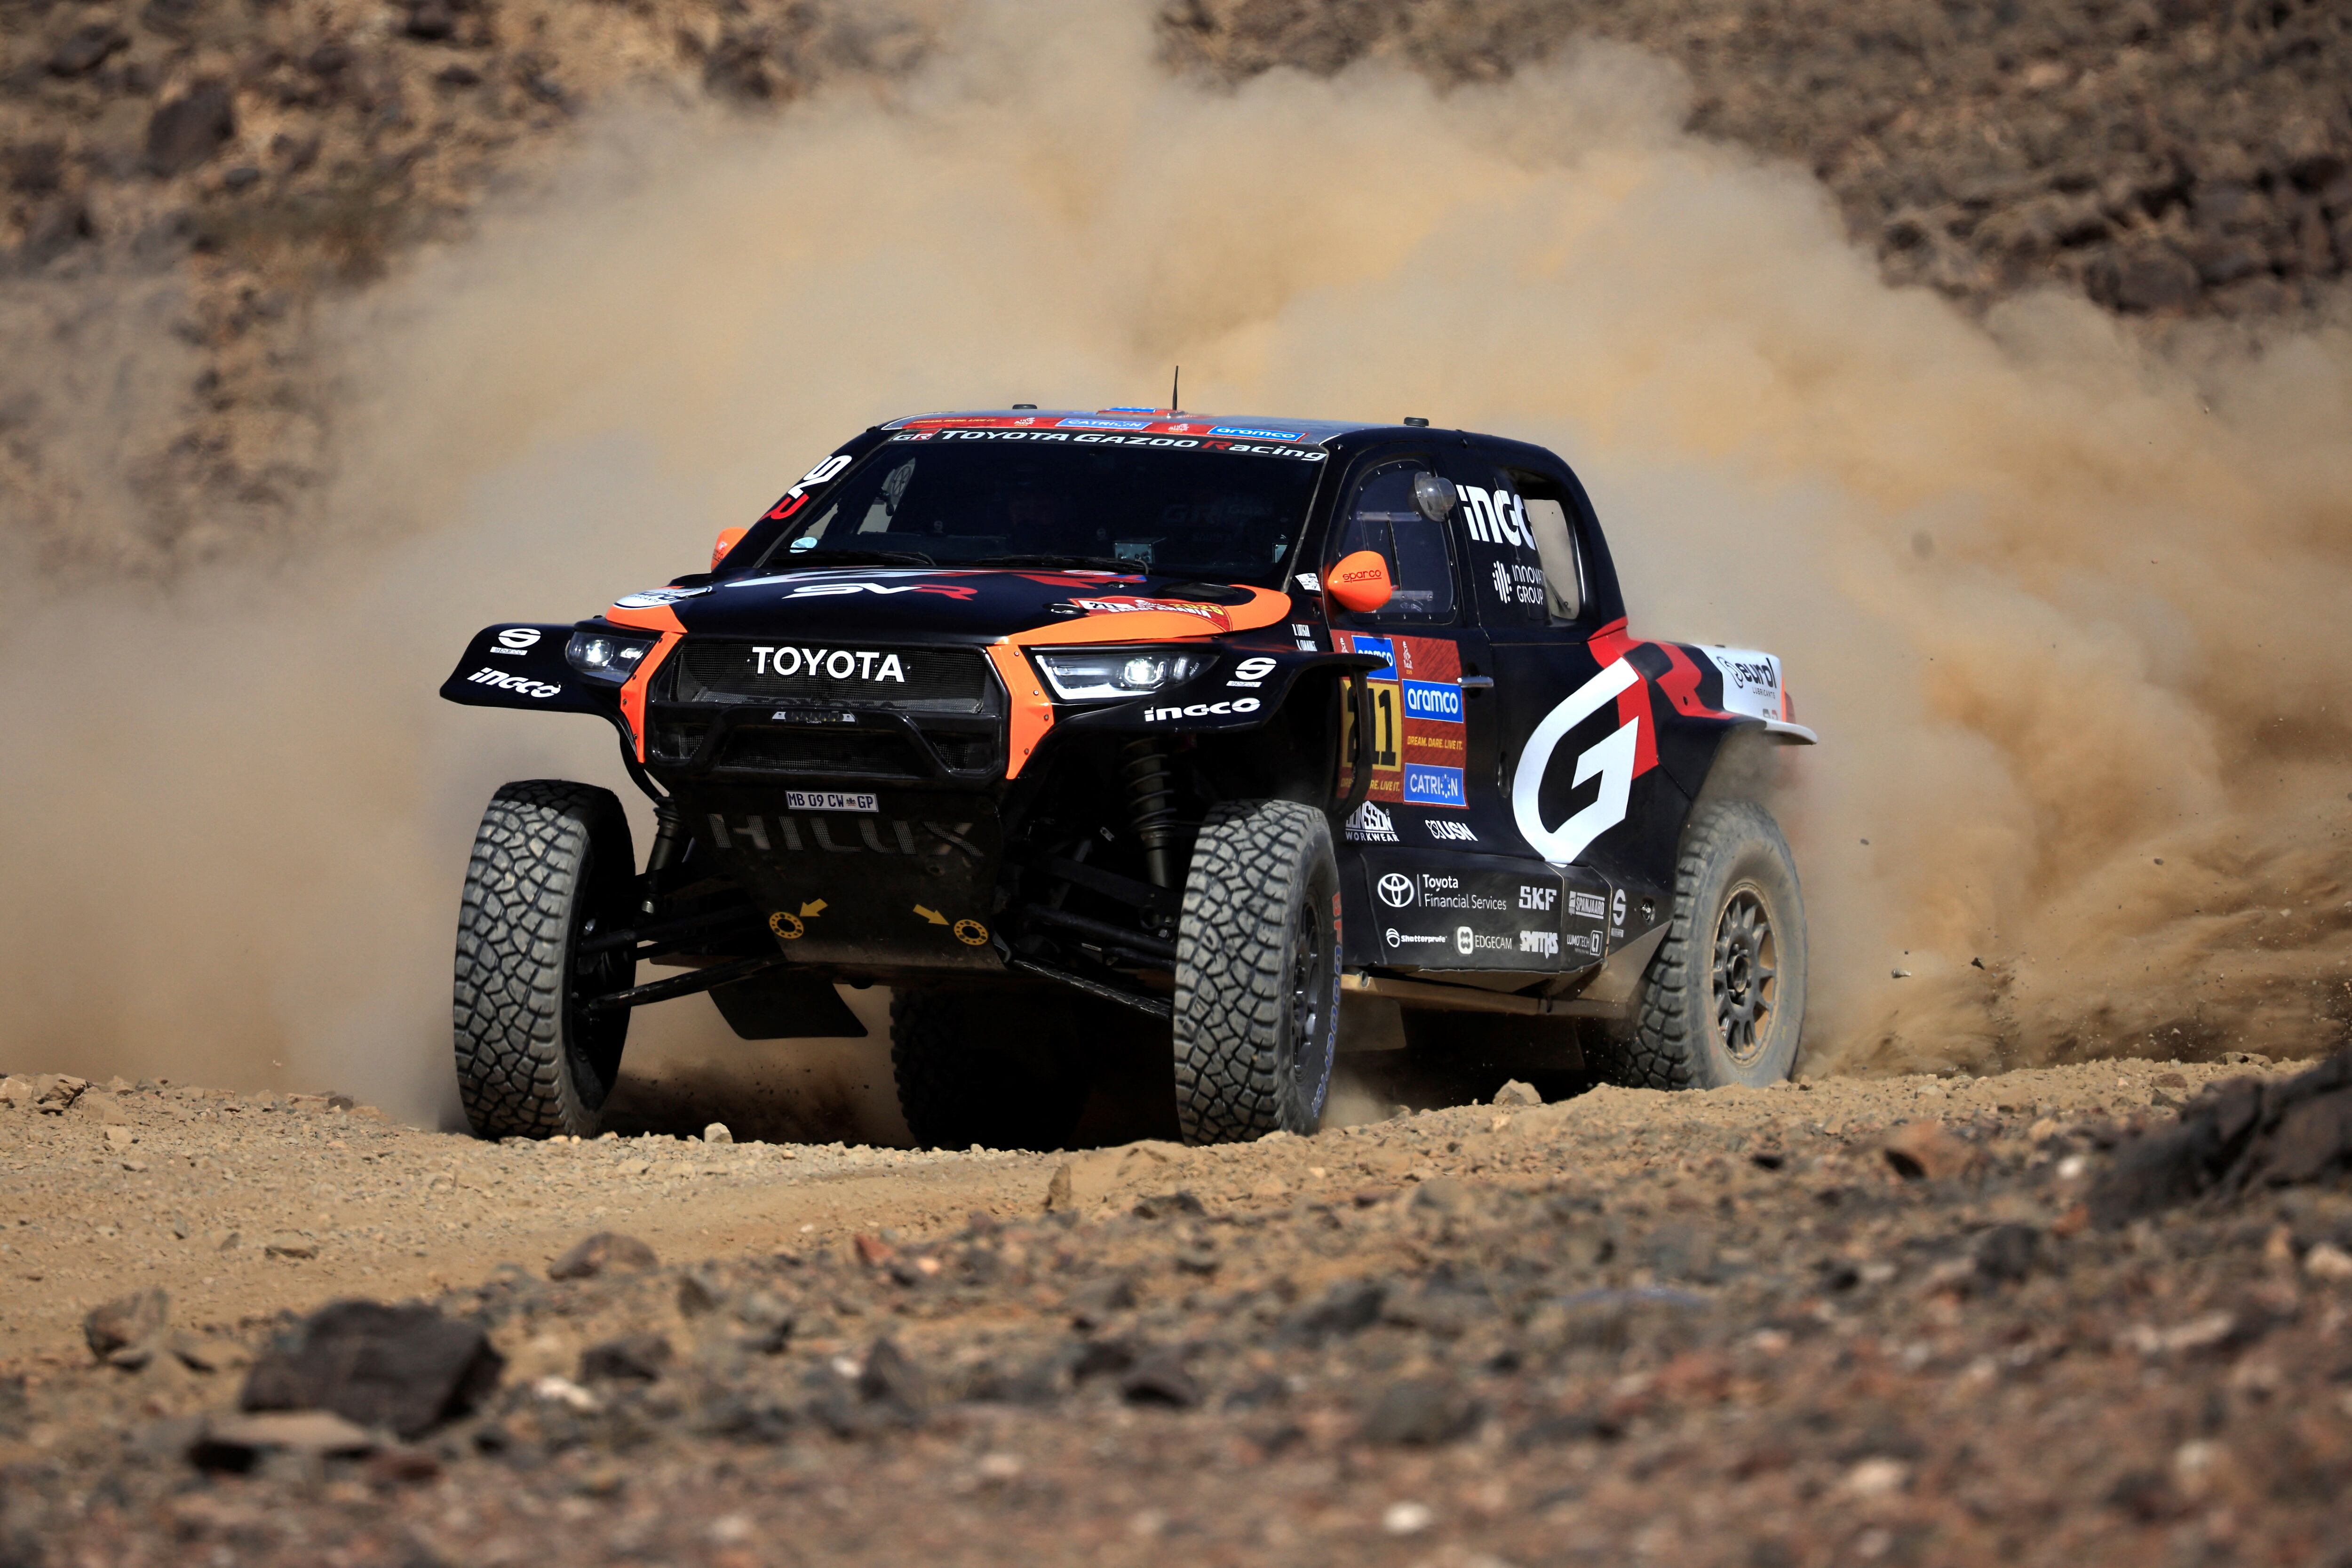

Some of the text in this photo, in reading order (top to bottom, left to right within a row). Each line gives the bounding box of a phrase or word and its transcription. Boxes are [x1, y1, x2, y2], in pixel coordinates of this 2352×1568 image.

[1216, 427, 1296, 438] aramco
[942, 430, 1070, 441] TOYOTA
[1073, 434, 1199, 447] GAZOO
[1201, 440, 1327, 461] Racing
[1343, 570, 1382, 583] sparco
[782, 583, 978, 601] SVR
[1517, 585, 1543, 605] GROUP
[1168, 603, 1224, 615] 2025
[752, 646, 905, 683] TOYOTA
[1735, 657, 1777, 689] eurol
[1407, 688, 1458, 714] aramco
[1752, 687, 1775, 699] LUBRICANTS
[1407, 735, 1427, 747] DREAM.
[1428, 738, 1444, 748] DARE.
[1445, 739, 1456, 750] LIVE
[1380, 780, 1393, 791] LIVE
[787, 793, 873, 809] MB 09 CW GP
[1345, 800, 1394, 831] JONSSON
[707, 813, 984, 857] HILUX
[1345, 831, 1400, 842] WORKWEAR
[1438, 820, 1479, 842] USN
[1422, 874, 1459, 892] Toyota
[1424, 893, 1507, 910] Financial Services
[1518, 885, 1557, 911] SKF
[1576, 896, 1605, 915] SPANJAARD
[1475, 935, 1512, 950] EDGECAM
[1519, 930, 1558, 959] SMITHS
[1567, 934, 1590, 948] LUMOTECH
